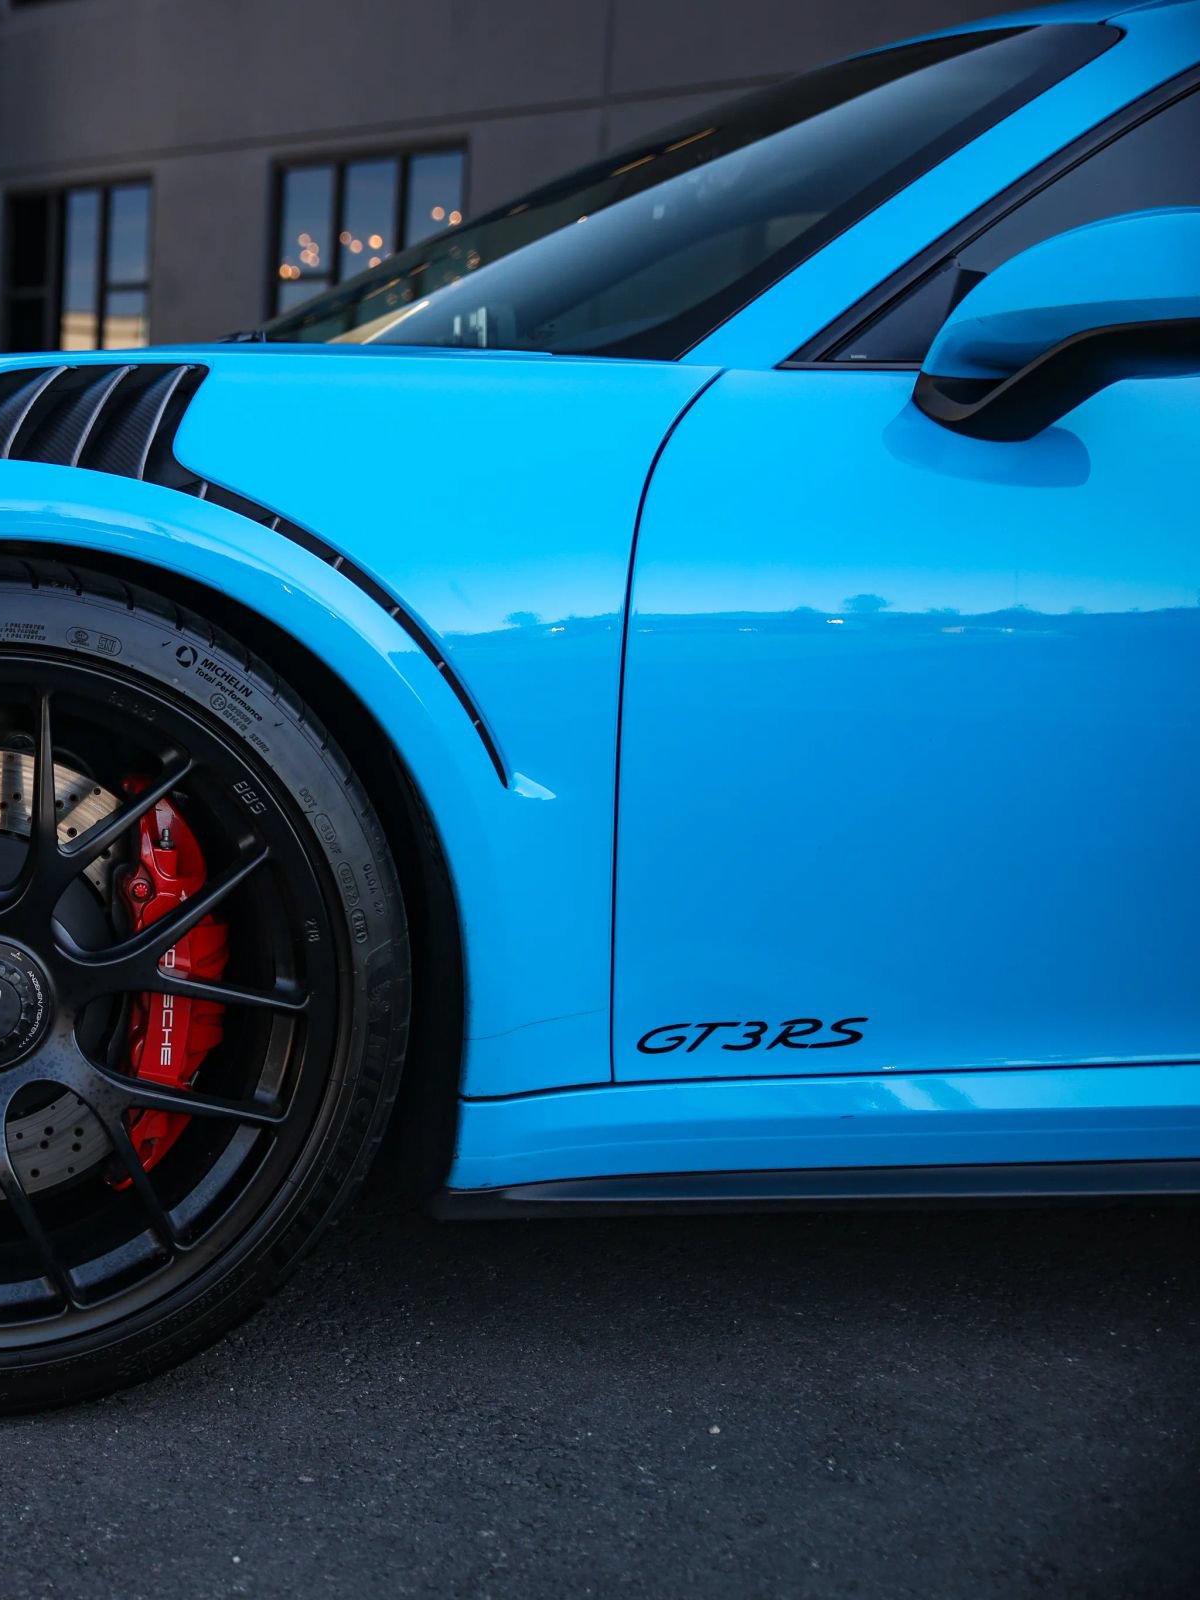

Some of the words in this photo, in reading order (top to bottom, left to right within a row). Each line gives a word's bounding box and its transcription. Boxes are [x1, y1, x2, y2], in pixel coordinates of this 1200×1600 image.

[195, 667, 216, 684] Total
[215, 681, 263, 722] Performance
[200, 658, 253, 698] MICHELIN
[232, 780, 267, 815] BBS
